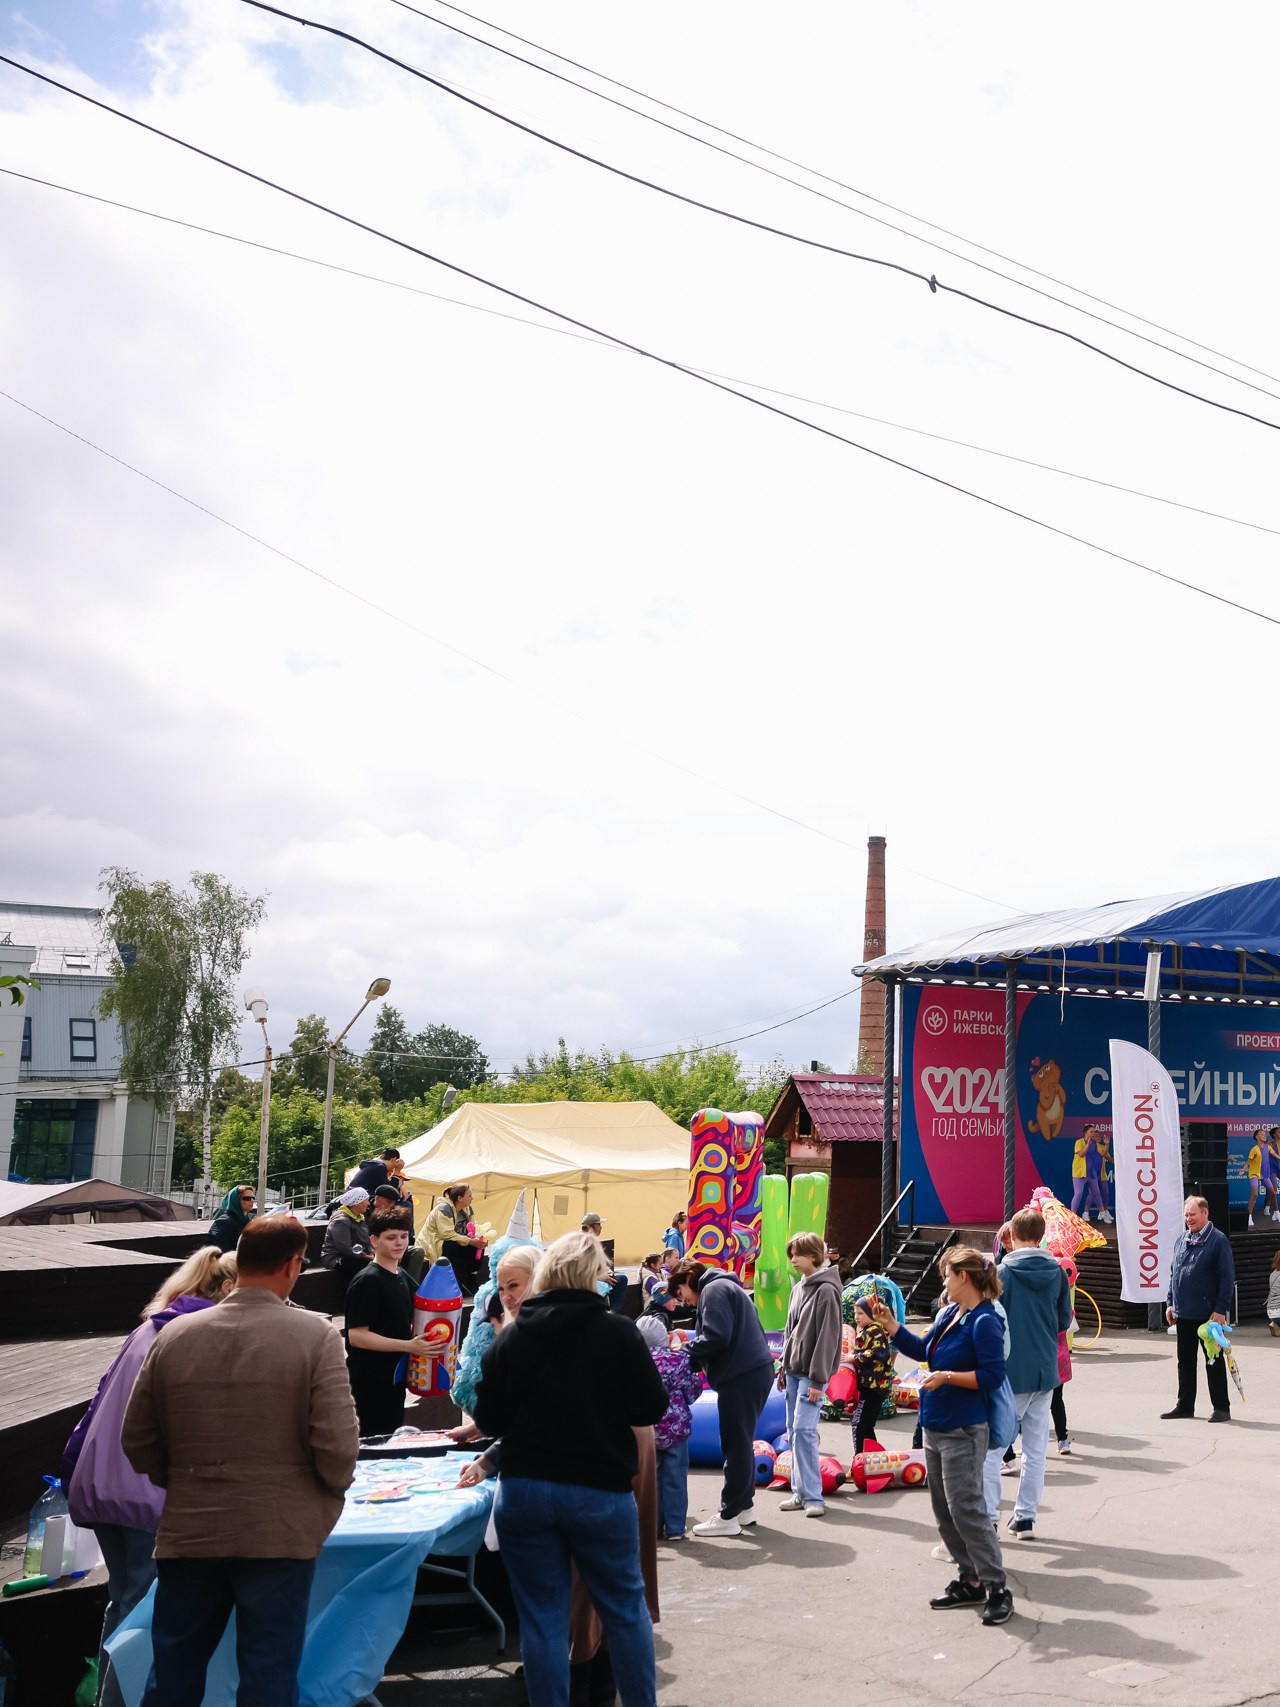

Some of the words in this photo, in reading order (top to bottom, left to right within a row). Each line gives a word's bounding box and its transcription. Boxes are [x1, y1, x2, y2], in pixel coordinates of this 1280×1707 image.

[953, 1009, 993, 1022] ПАРКИ
[921, 1066, 1006, 1114] 2024
[1233, 1123, 1244, 1132] НА
